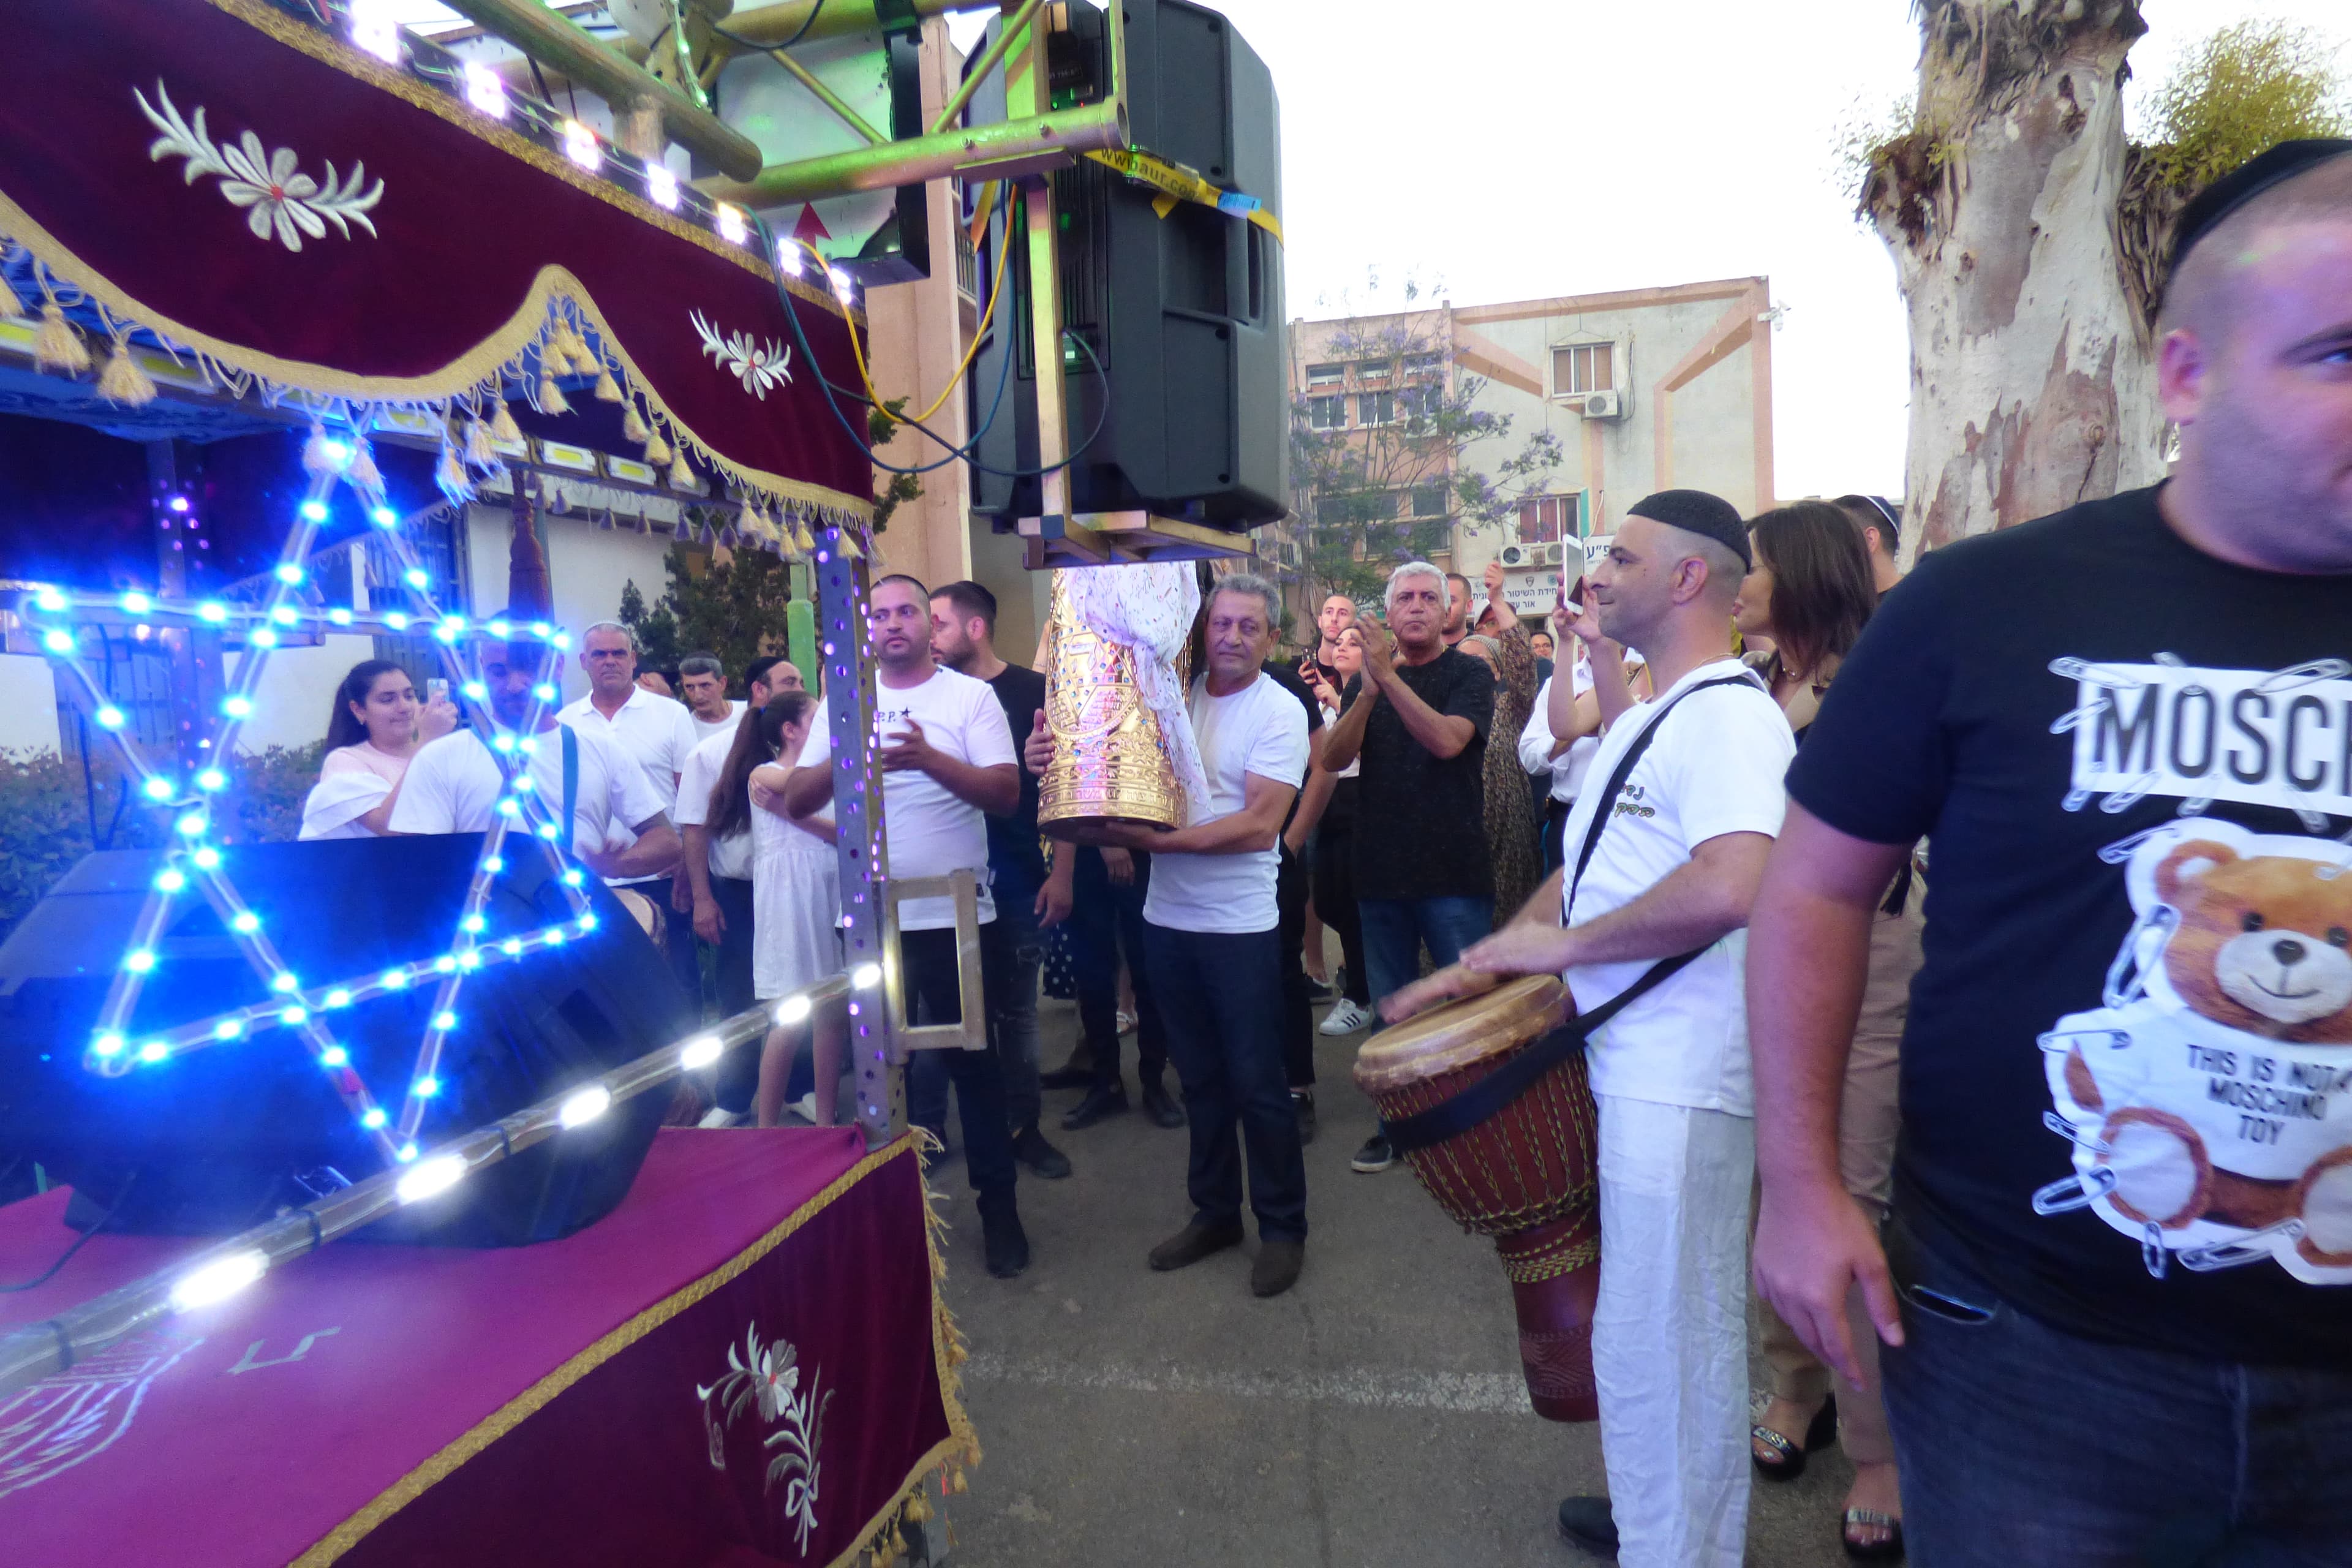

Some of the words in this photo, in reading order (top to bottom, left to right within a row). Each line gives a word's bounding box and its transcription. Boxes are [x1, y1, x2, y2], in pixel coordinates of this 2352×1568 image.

[1507, 589, 1536, 598] השיטור
[1537, 587, 1558, 596] חידת
[2187, 1044, 2237, 1077] THIS
[2250, 1055, 2276, 1083] IS
[2286, 1061, 2337, 1091] NOT
[2207, 1077, 2328, 1121] MOSCHINO
[2238, 1114, 2286, 1146] TOY
